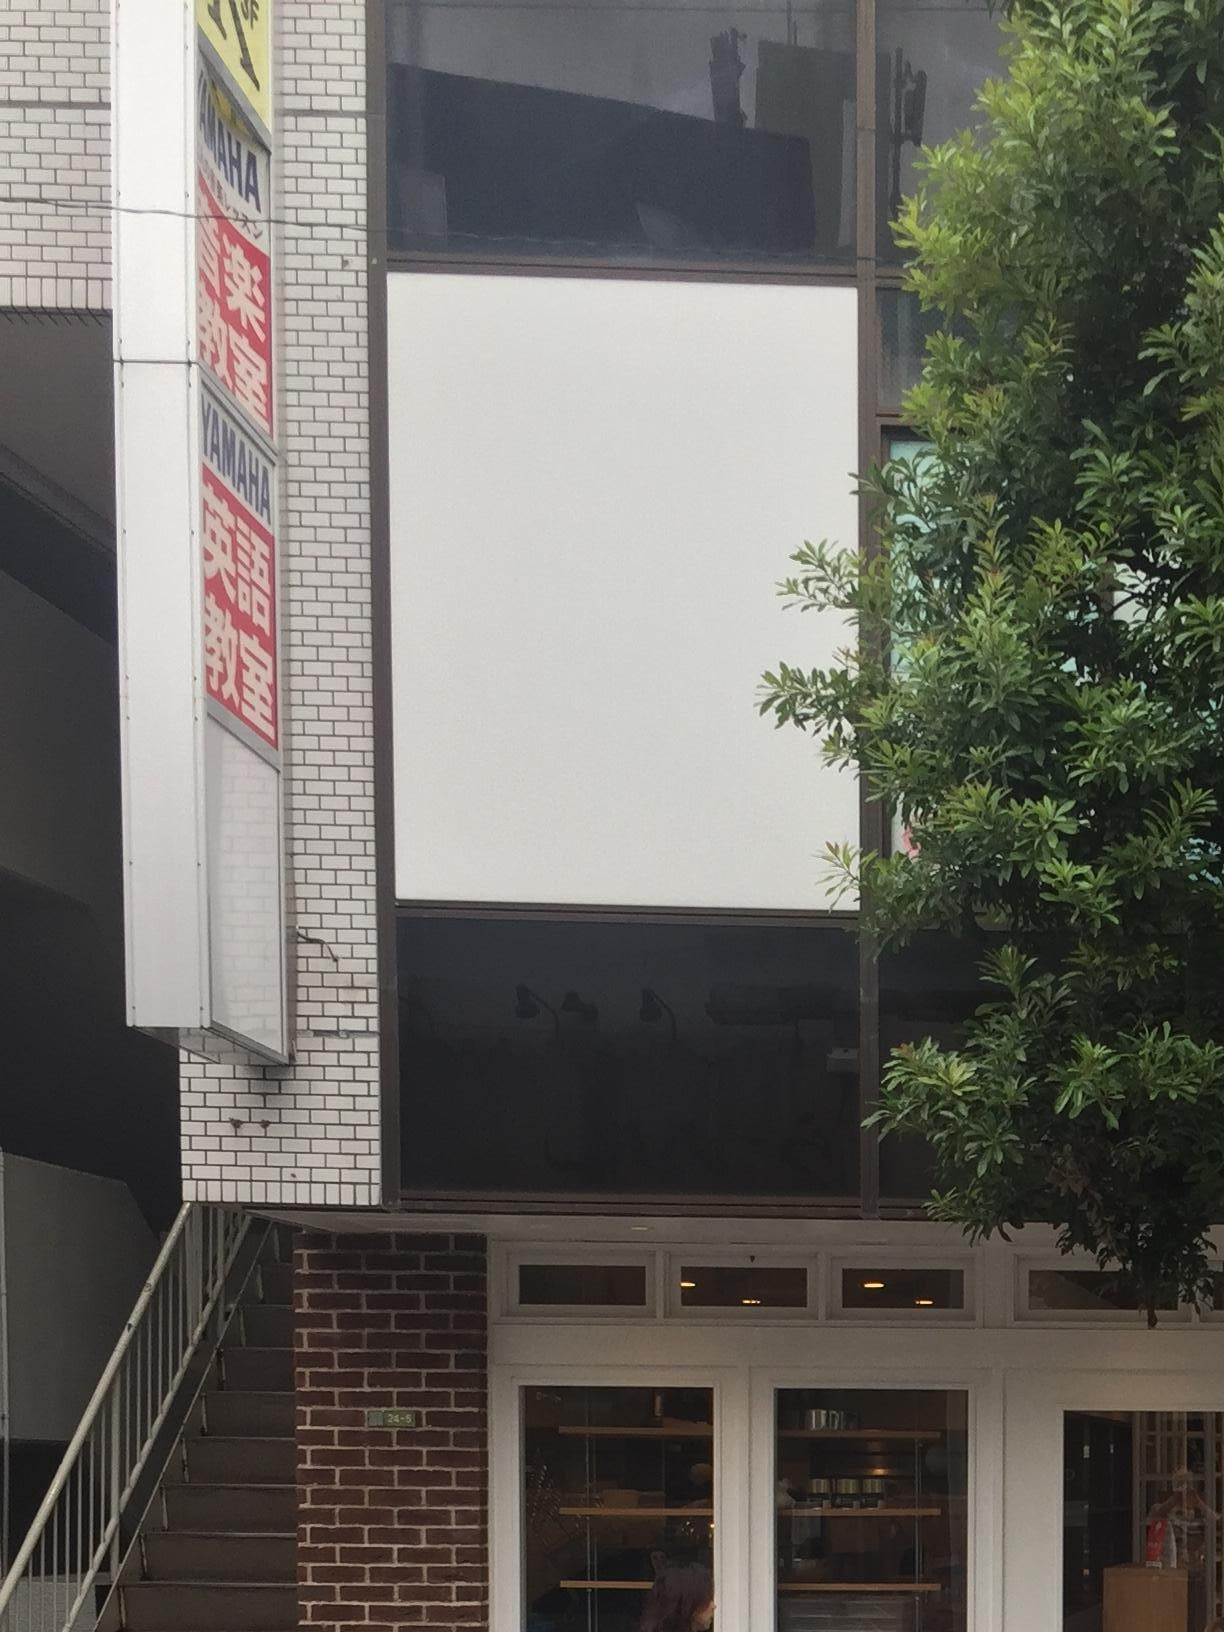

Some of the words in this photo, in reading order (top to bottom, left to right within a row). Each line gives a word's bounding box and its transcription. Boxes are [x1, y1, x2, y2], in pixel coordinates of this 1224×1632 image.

[201, 393, 271, 525] YAMAHA
[200, 481, 271, 637] 英語
[203, 591, 276, 741] 教室
